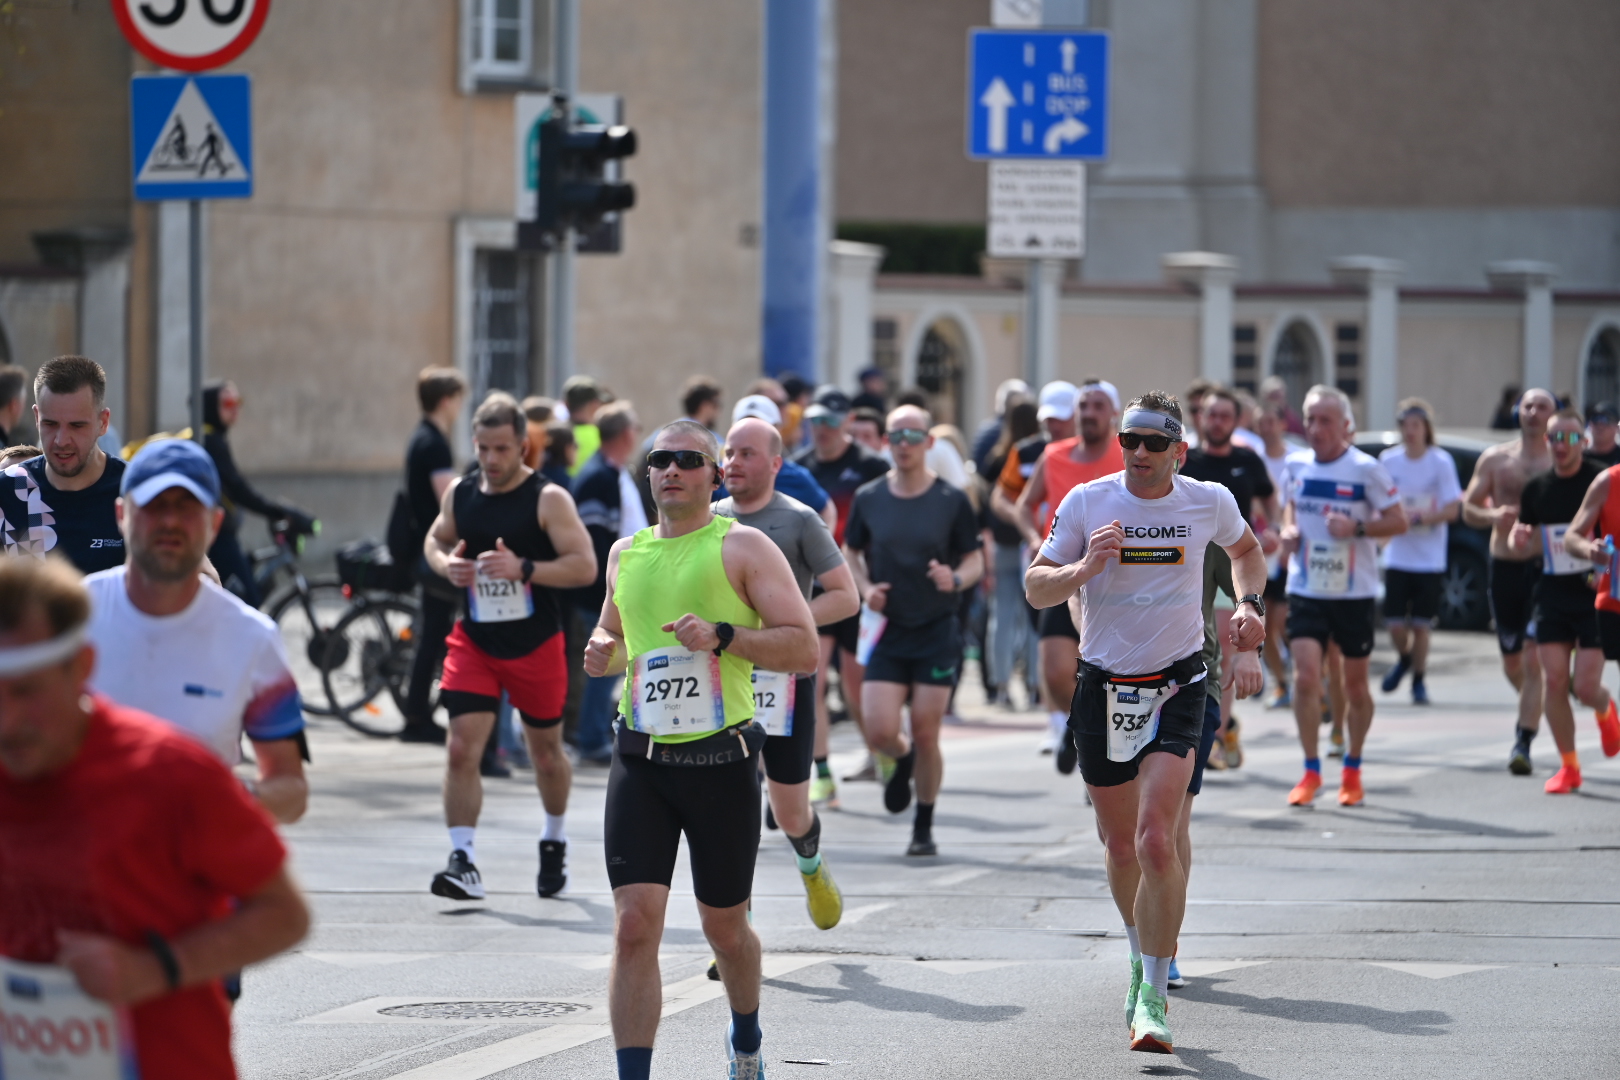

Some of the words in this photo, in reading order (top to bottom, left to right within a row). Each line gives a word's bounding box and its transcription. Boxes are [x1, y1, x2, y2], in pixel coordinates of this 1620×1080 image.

[1047, 72, 1088, 93] BUS
[1118, 525, 1187, 539] ECOME
[90, 538, 104, 548] 23
[477, 581, 517, 597] 11221
[644, 676, 700, 704] 2972
[664, 703, 682, 711] Piotr
[752, 691, 776, 708] 12
[661, 750, 733, 765] EVADICT
[0, 1010, 109, 1057] 0001
